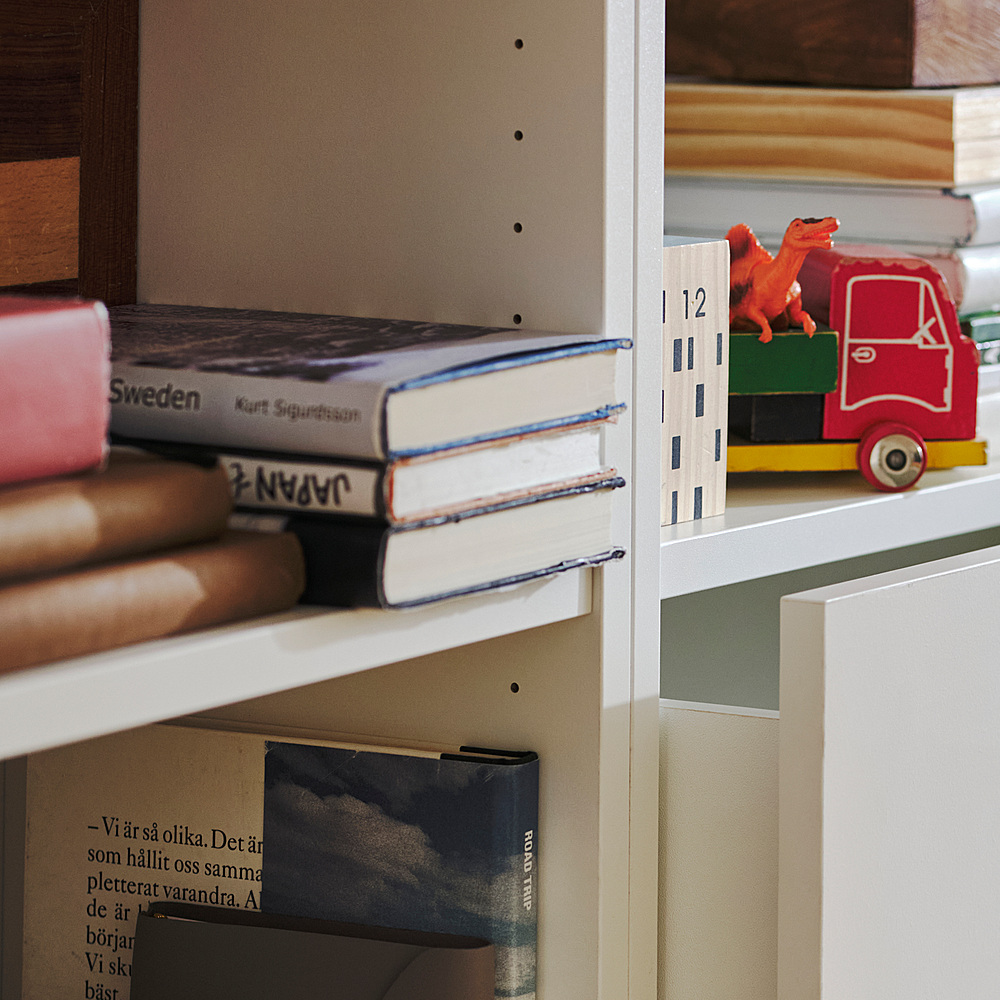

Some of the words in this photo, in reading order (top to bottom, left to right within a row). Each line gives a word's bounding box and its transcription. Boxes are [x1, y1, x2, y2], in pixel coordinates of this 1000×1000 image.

[682, 287, 706, 319] 12
[109, 378, 201, 410] Sweden
[255, 465, 351, 506] JAPAN
[123, 821, 140, 839] är
[142, 822, 159, 842] så
[162, 824, 208, 848] olika.
[211, 828, 245, 852] Det
[524, 829, 533, 873] ROAD
[87, 848, 121, 866] som
[126, 847, 170, 871] hållit
[174, 858, 200, 875] oss
[87, 871, 159, 898] pletterat
[163, 885, 240, 908] varandra.
[523, 875, 532, 911] TRIP
[87, 898, 107, 918] de
[114, 903, 130, 921] är
[85, 952, 103, 974] Vi
